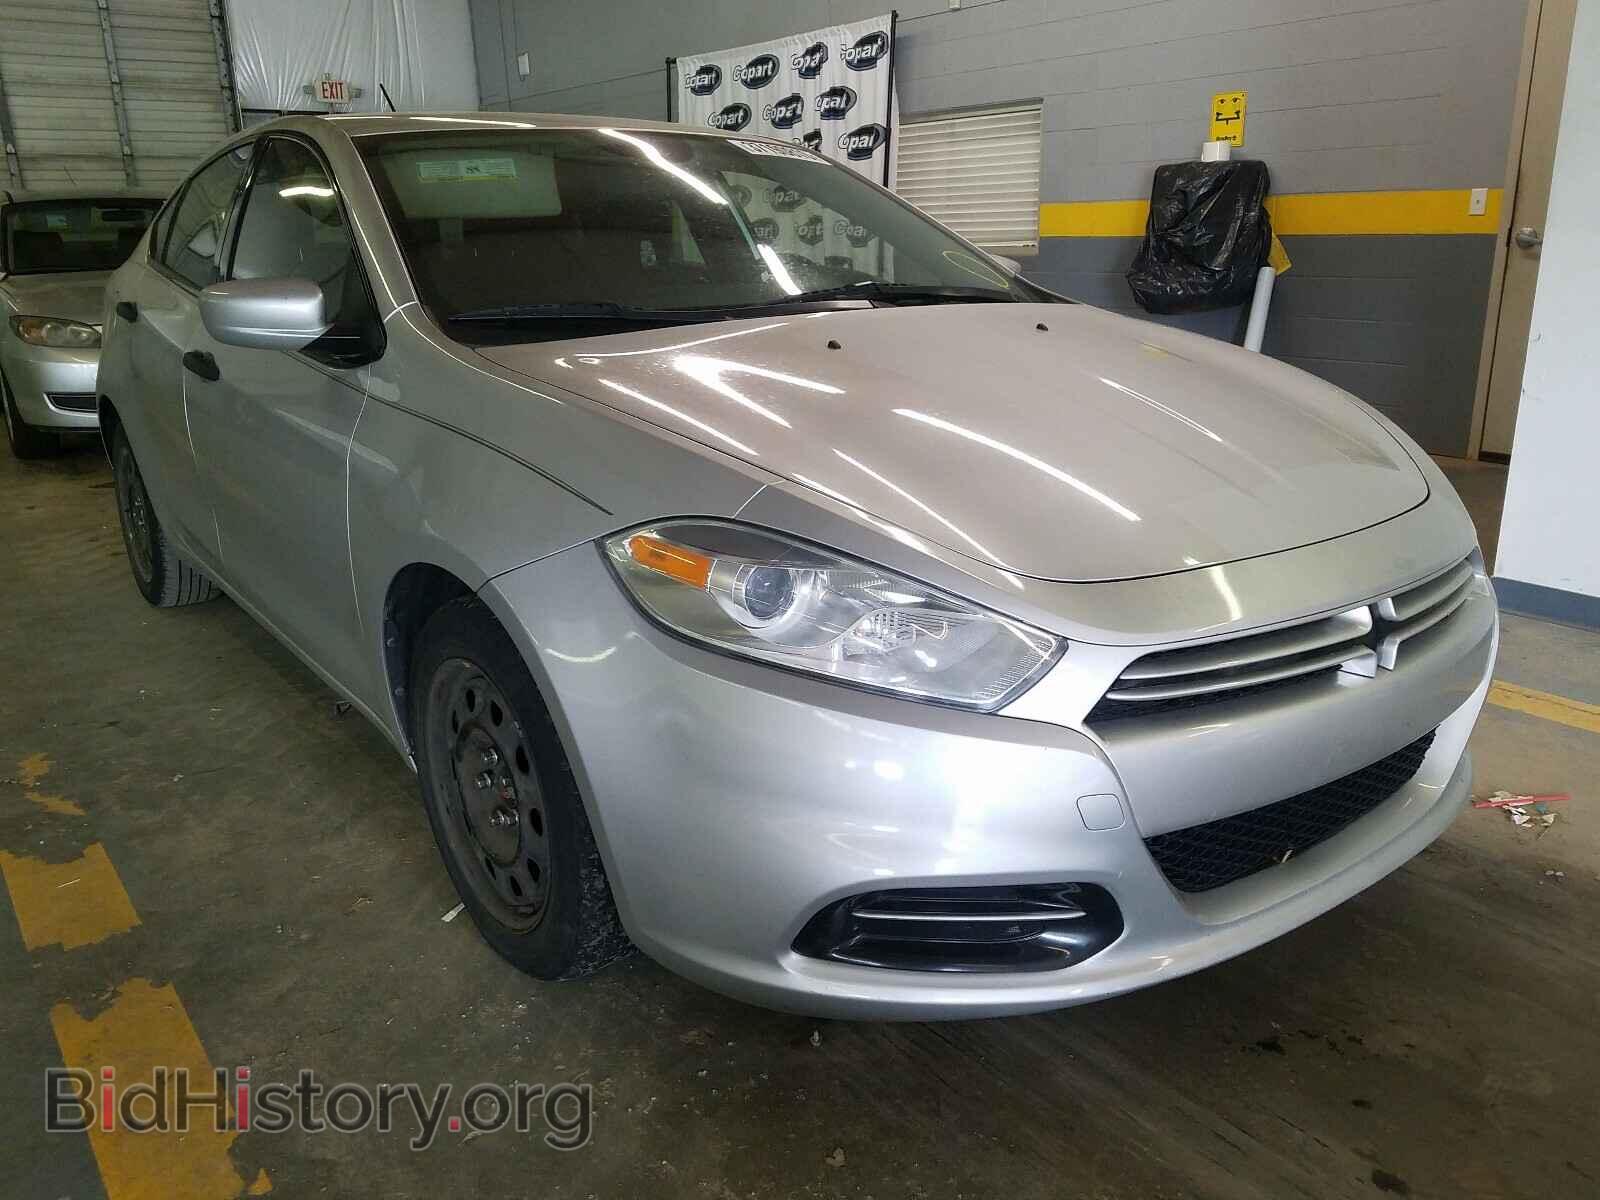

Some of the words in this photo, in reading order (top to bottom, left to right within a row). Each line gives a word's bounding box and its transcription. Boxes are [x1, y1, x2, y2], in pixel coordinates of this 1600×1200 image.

[733, 60, 774, 82] Copart
[321, 81, 344, 99] EXIT
[708, 109, 745, 129] Copart
